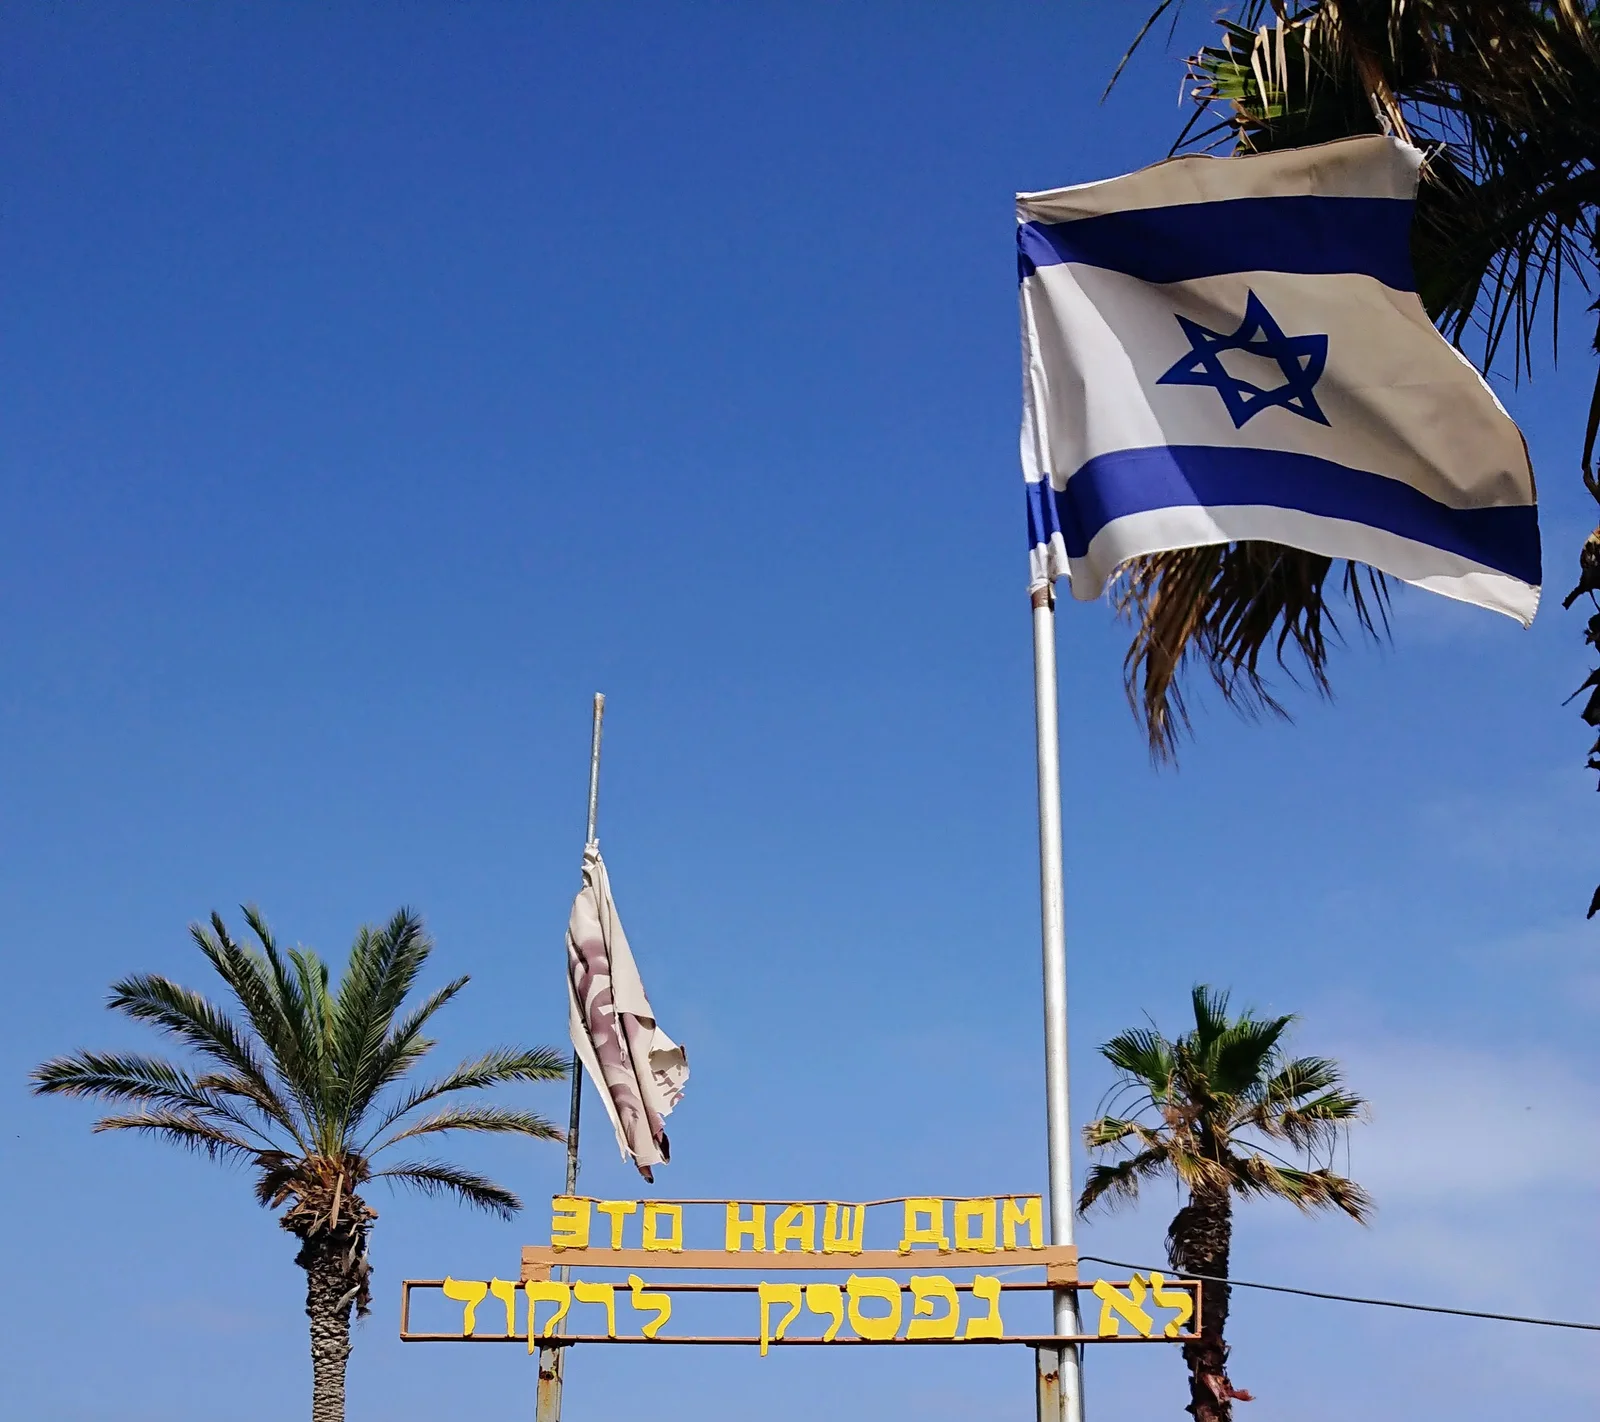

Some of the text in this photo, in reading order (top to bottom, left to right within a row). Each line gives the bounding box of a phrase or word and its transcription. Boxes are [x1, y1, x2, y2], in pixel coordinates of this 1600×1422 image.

[551, 1197, 1044, 1254] ЭТО НАШ ДОМ
[443, 1271, 1193, 1357] לא נפסיק לרקוד
